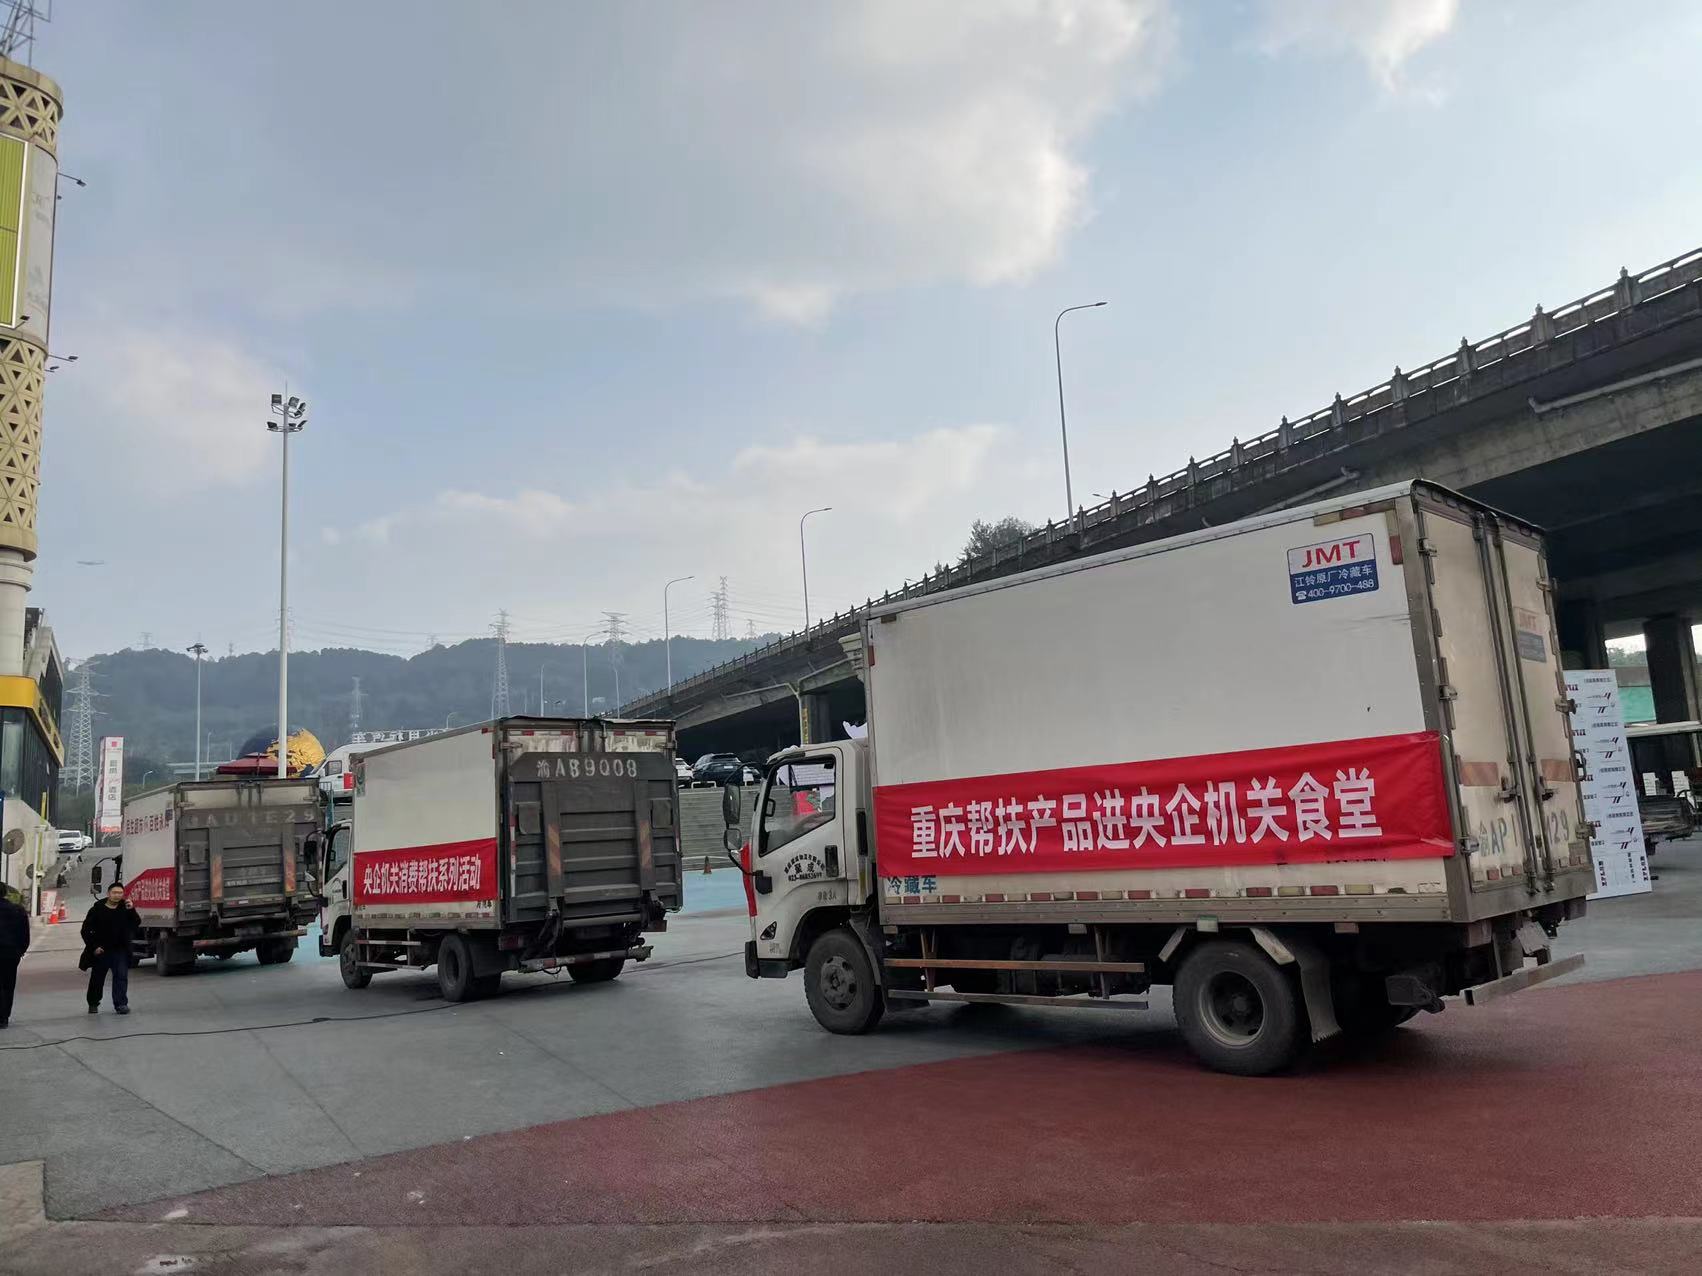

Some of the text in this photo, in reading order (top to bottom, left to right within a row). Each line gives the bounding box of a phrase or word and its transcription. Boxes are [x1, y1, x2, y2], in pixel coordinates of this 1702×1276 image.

[1302, 540, 1360, 568] JMT
[1294, 564, 1373, 588] 江铃原厂冷藏车
[911, 767, 1383, 858] 重庆帮扶产品进央企机关食堂
[363, 854, 481, 895] 央企机关消费帮扶系列活动
[887, 875, 937, 895] 冷藏车
